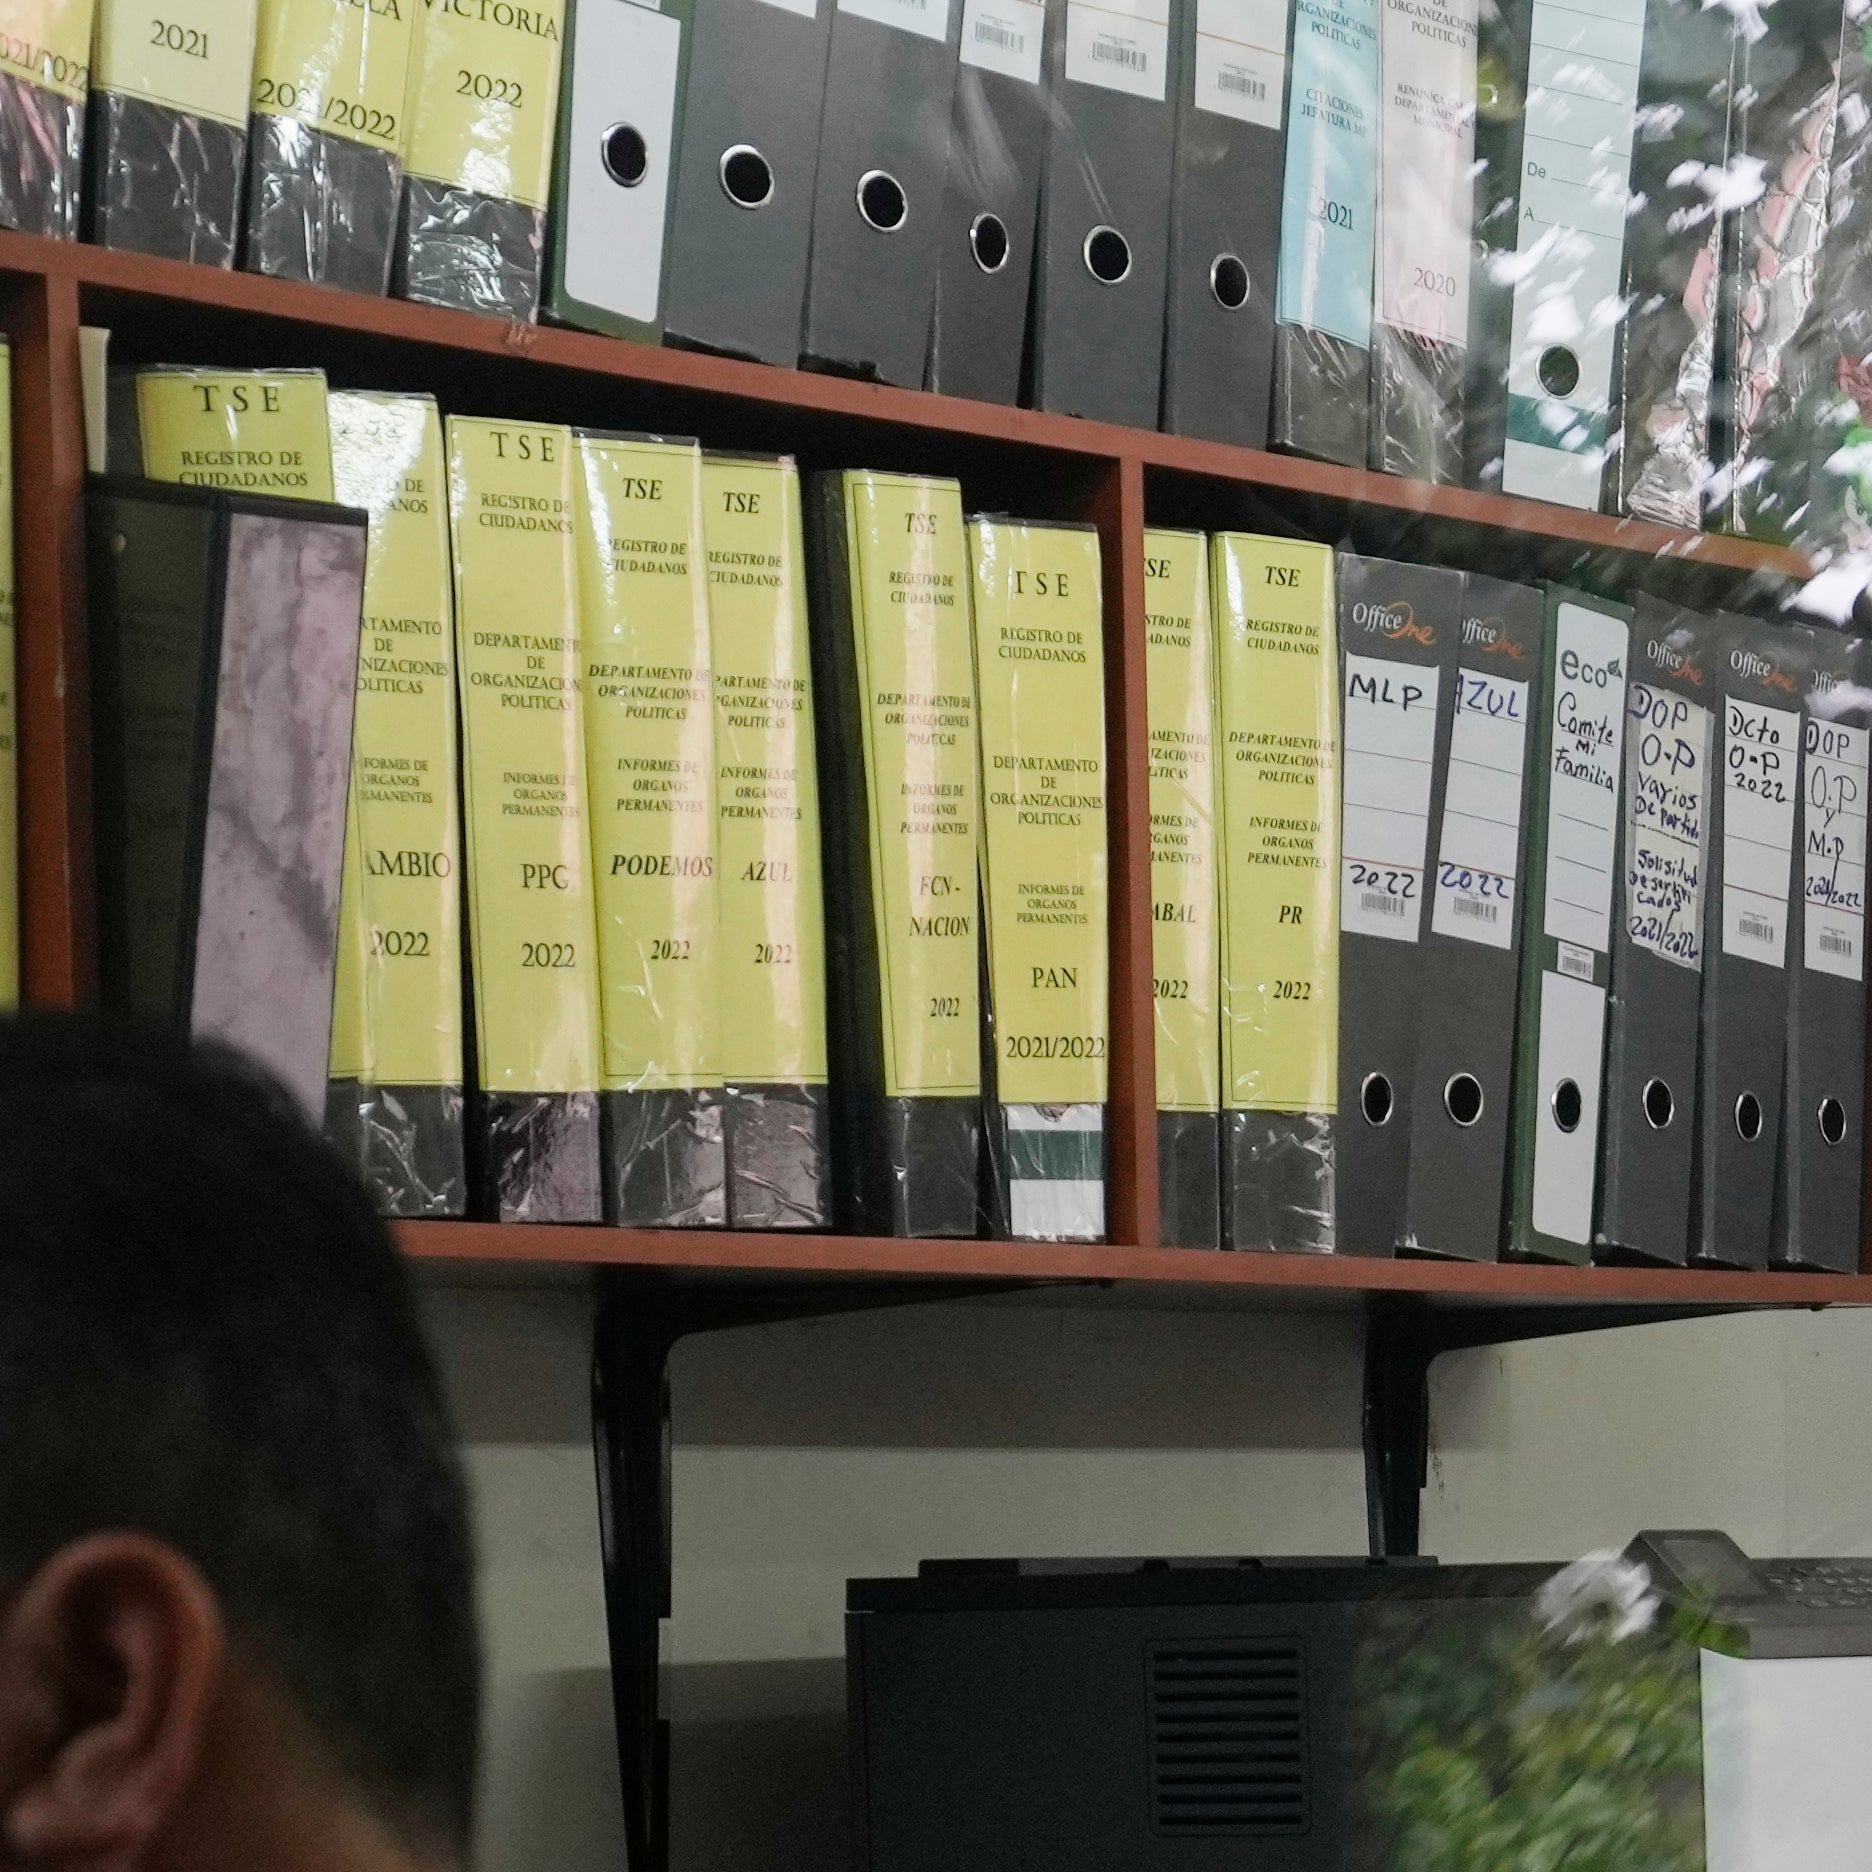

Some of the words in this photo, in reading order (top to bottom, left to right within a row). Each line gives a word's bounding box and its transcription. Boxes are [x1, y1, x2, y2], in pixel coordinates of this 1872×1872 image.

[150, 19, 210, 59] 2021
[1412, 21, 1466, 48] POLITICAS
[180, 448, 270, 469] REGISTRO
[279, 451, 302, 469] DE
[622, 476, 663, 502] TSE
[1264, 565, 1301, 588] TSE
[1000, 627, 1061, 644] REGISTRO
[1066, 630, 1082, 644] DE
[998, 646, 1086, 663] CIUDADANOS
[1560, 649, 1608, 688] eco
[1349, 672, 1423, 711] MLP
[624, 704, 688, 722] POLITICAS
[993, 755, 1098, 773] DEPARTAMENTO
[1736, 774, 1786, 803] 2022
[990, 791, 1104, 810] ORGANIZACIONES
[1018, 811, 1081, 827] POLITICAS
[520, 862, 570, 892] PPG
[610, 851, 713, 880] PODEMOS
[740, 860, 792, 883] AZUL
[1350, 864, 1416, 898] 2022
[1278, 904, 1303, 925] PR
[909, 916, 970, 937] NACION
[650, 938, 691, 963] 2022
[1032, 967, 1078, 989] PAN
[930, 997, 960, 1017] 2022
[1006, 1036, 1106, 1059] 2021/2022
